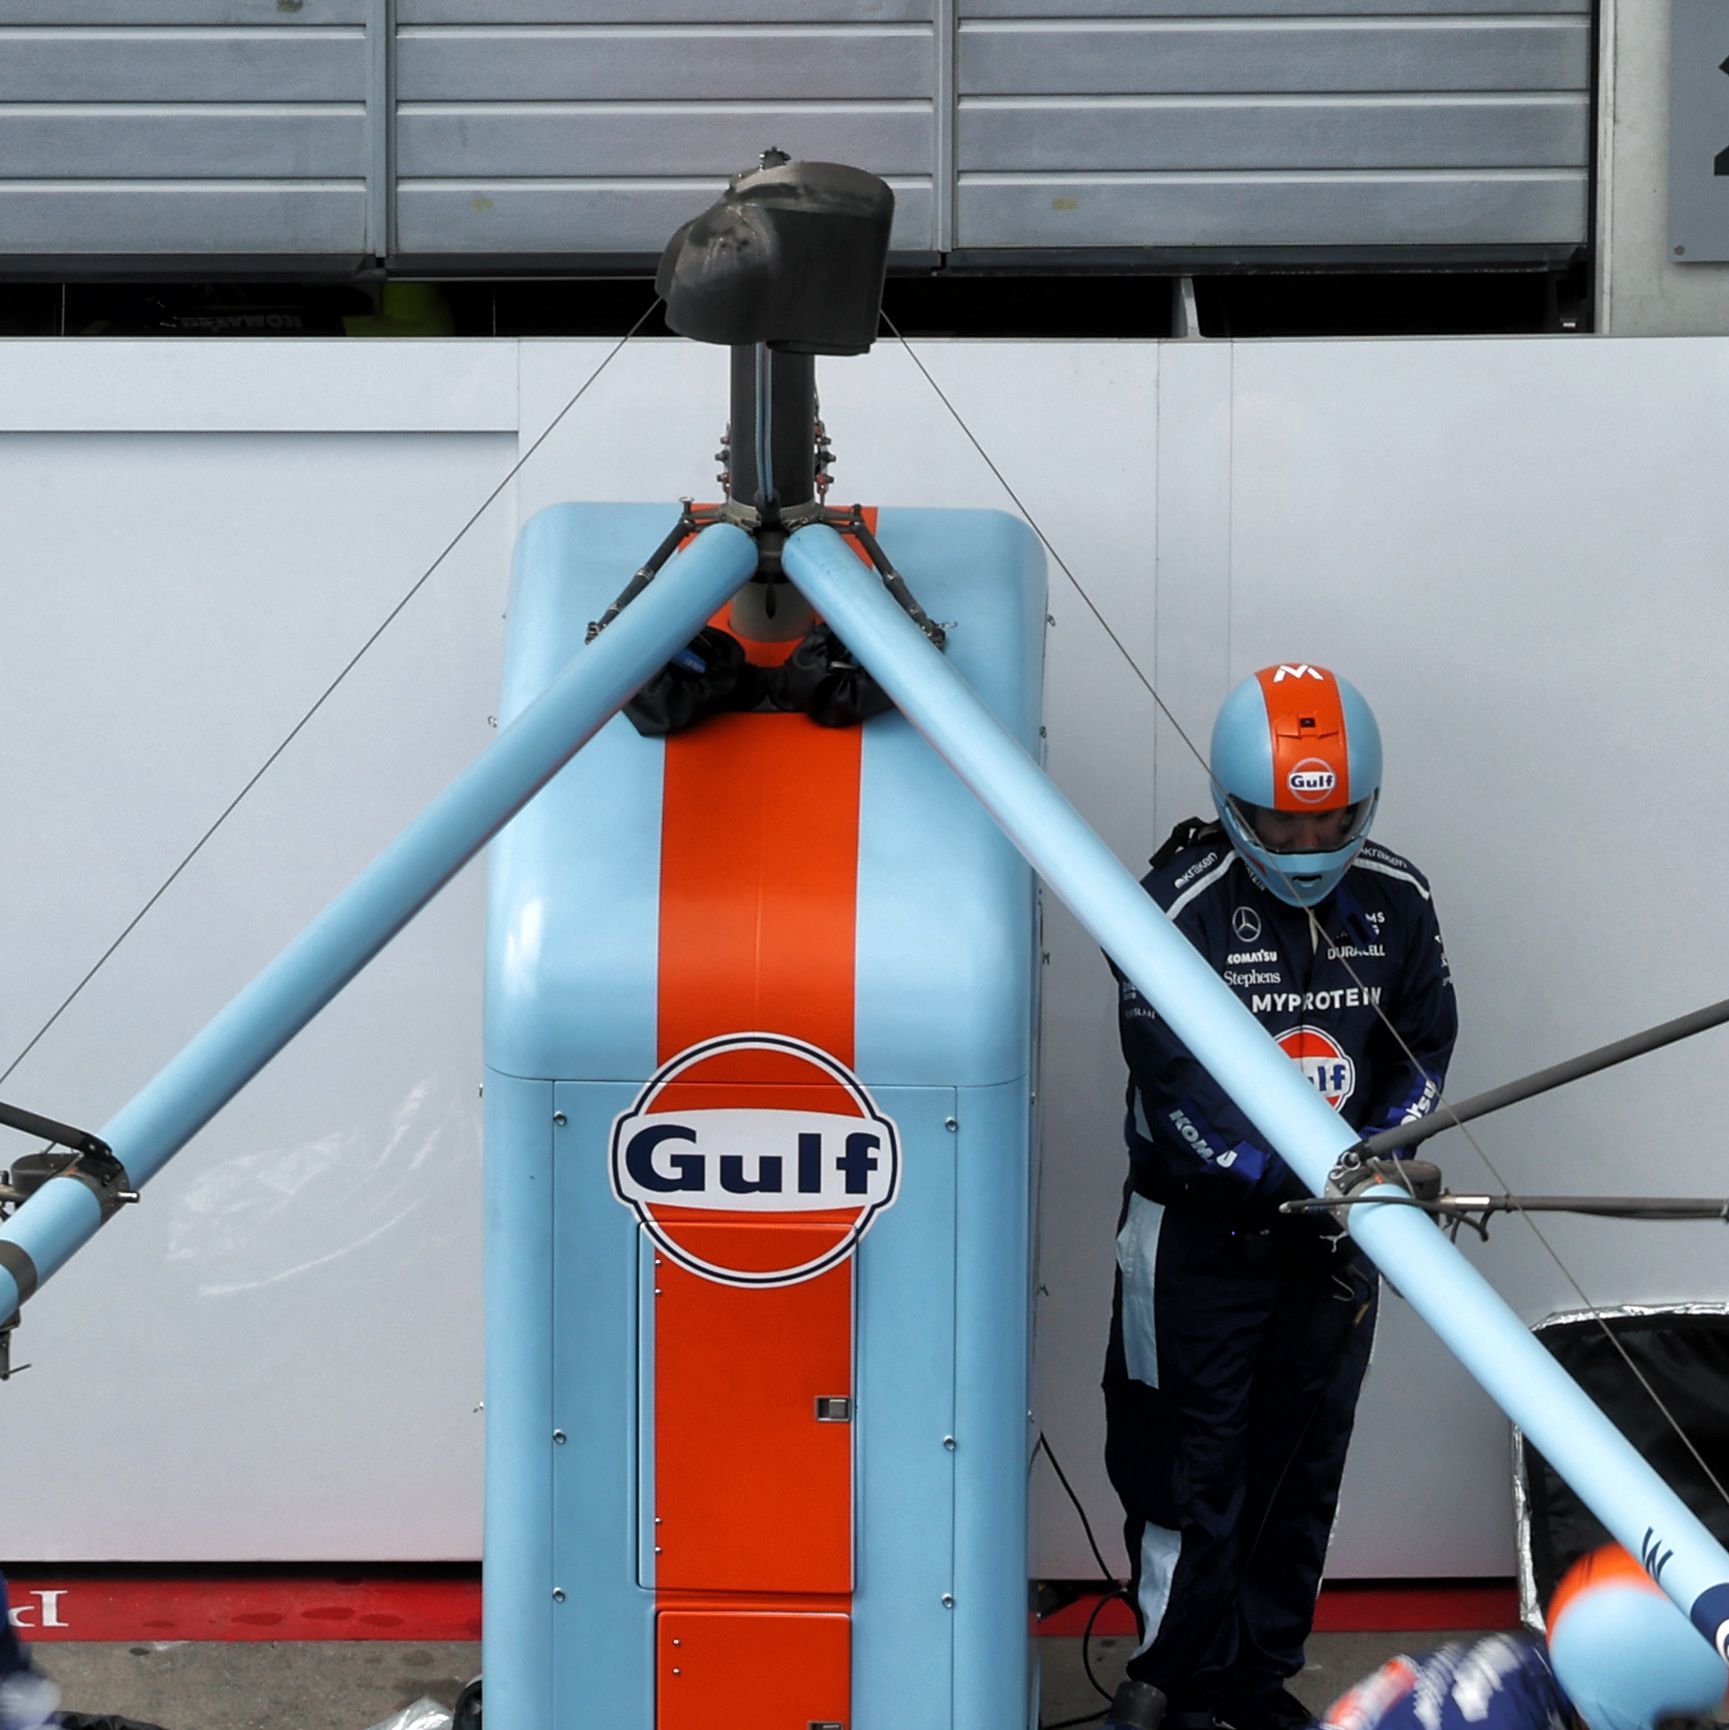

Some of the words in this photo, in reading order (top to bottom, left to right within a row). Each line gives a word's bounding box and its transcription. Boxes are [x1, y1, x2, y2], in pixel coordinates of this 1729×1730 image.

[1289, 774, 1334, 790] Gulf
[1226, 948, 1278, 965] KOMATSU
[1223, 969, 1282, 988] Stephens
[1309, 1064, 1347, 1092] lf
[625, 1123, 881, 1195] Gulf
